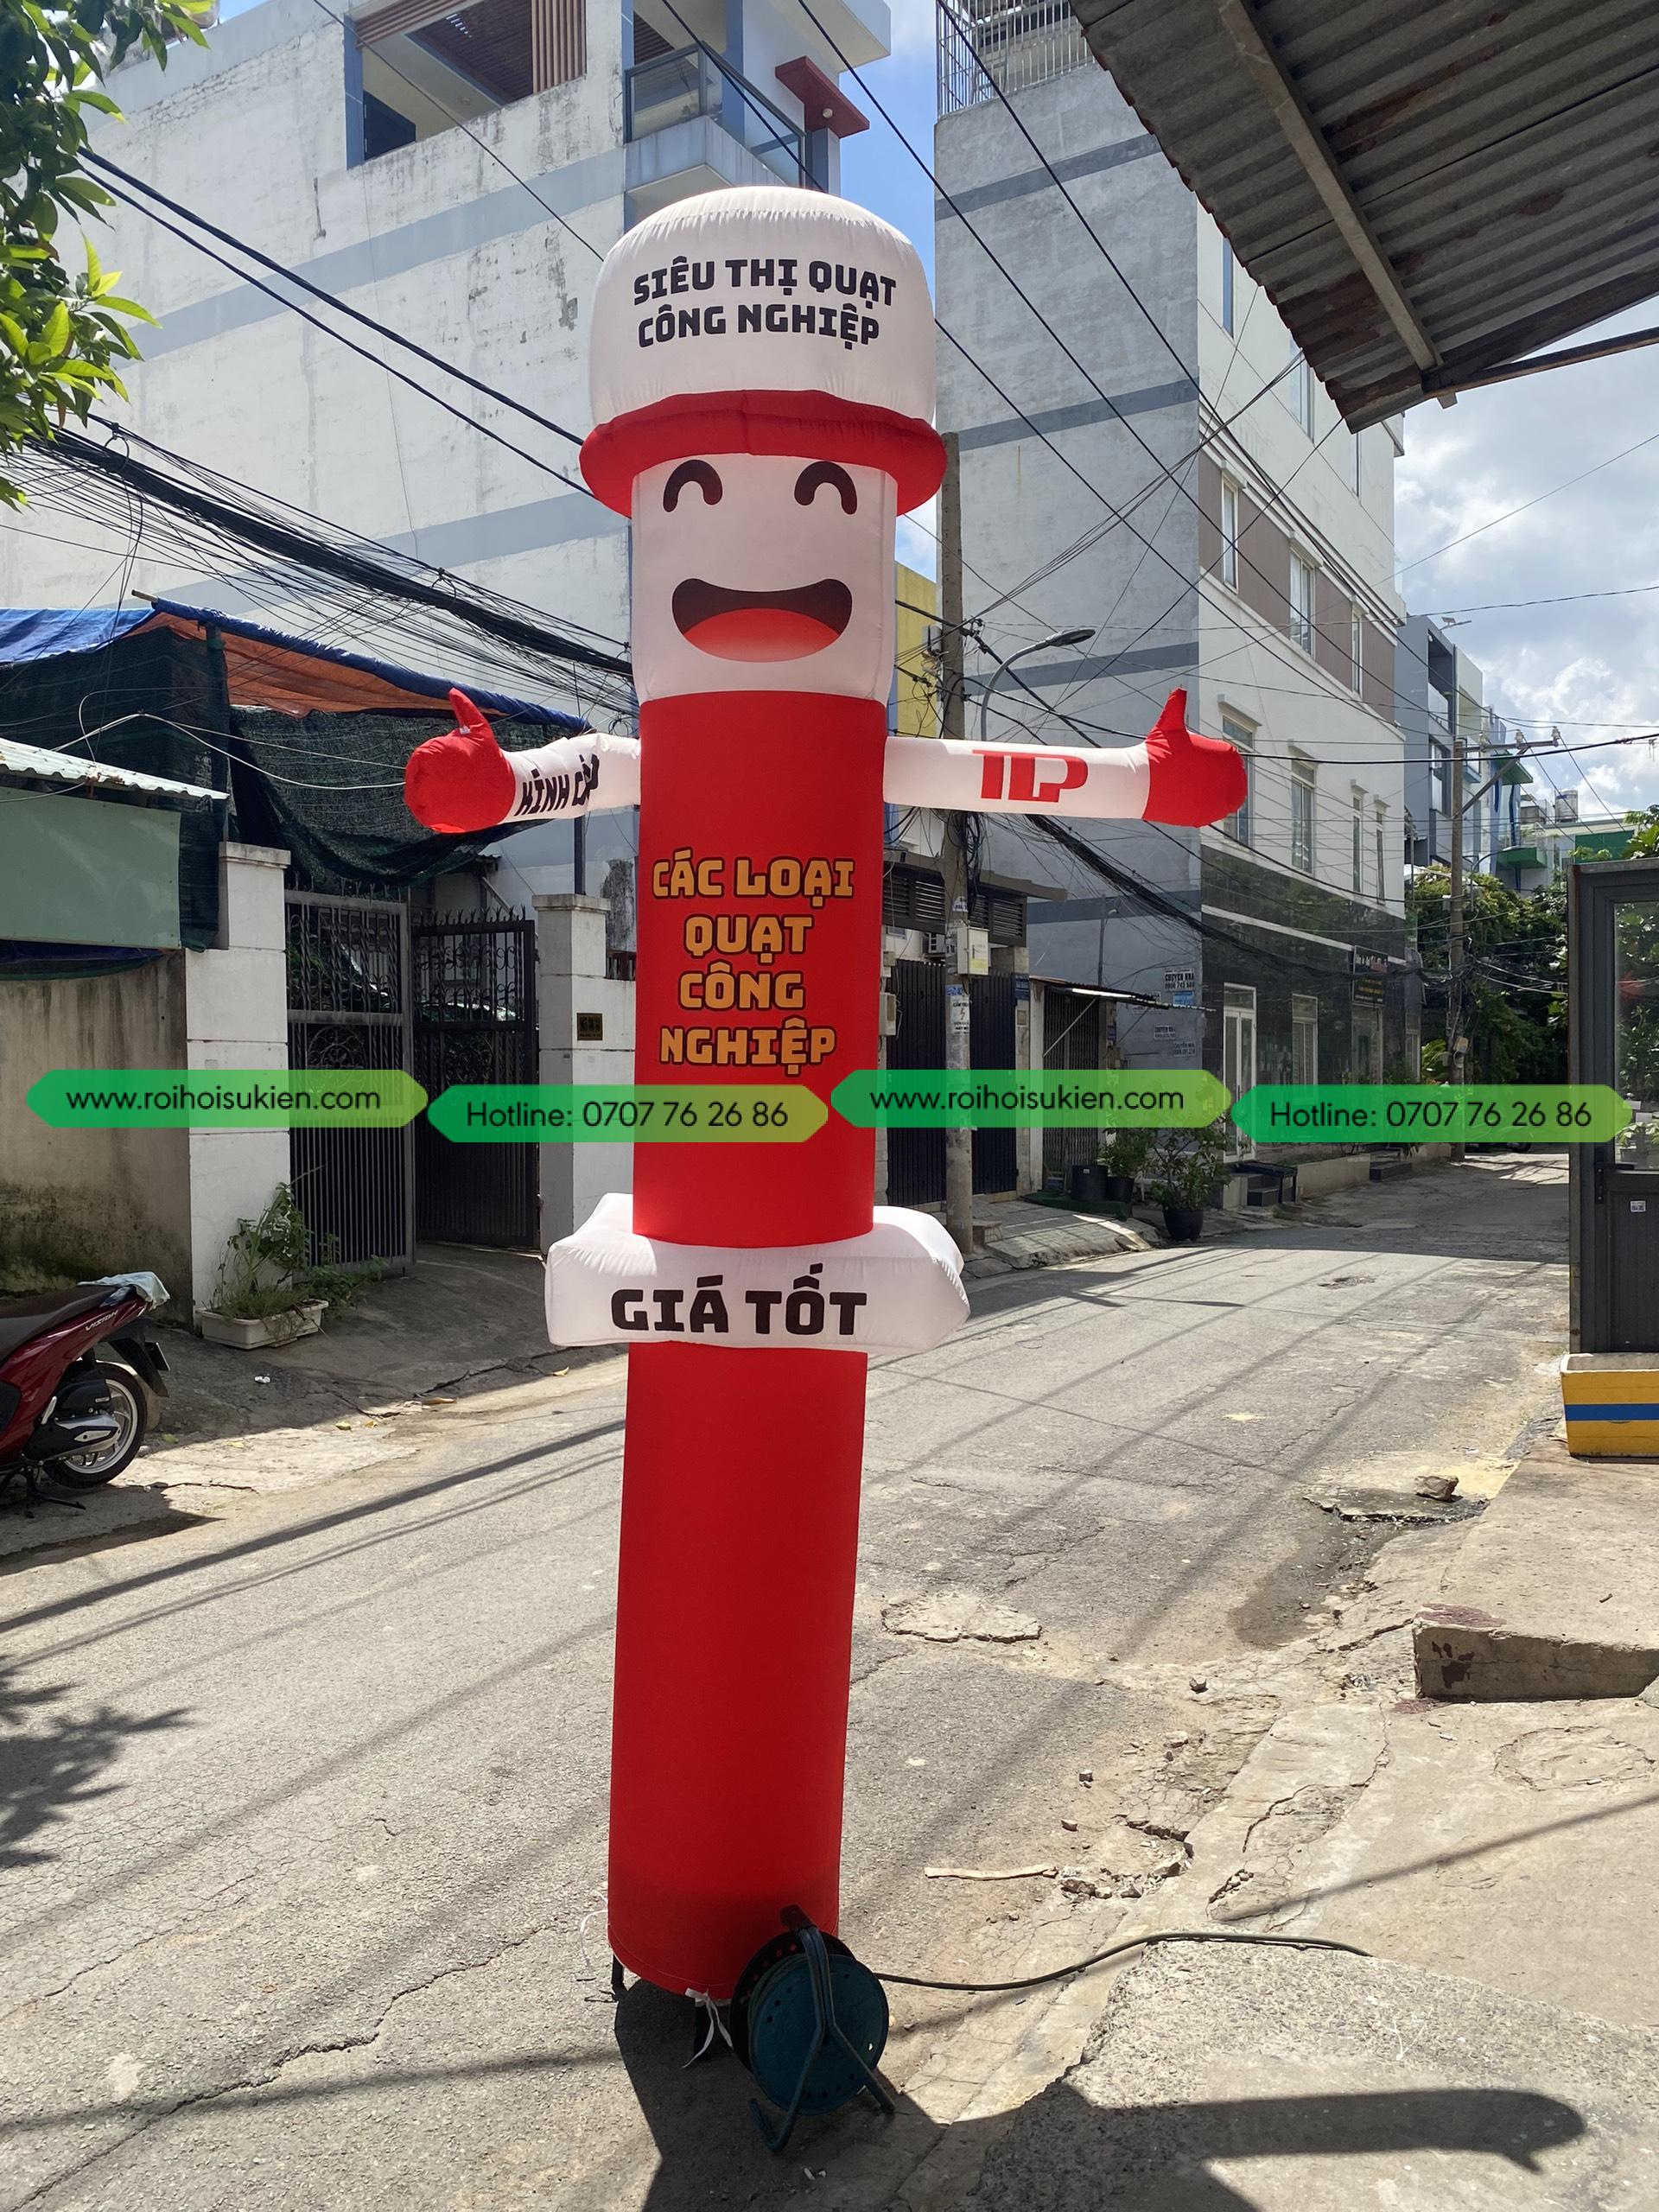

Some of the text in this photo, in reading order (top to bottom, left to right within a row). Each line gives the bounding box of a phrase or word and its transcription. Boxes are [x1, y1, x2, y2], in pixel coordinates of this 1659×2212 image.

[633, 255, 897, 309] SIÊU THỊ QUẠT
[638, 302, 880, 350] CÔNG NGHIỆP
[653, 847, 855, 908] CÁC LOẠI
[683, 914, 814, 964] QUẠT
[678, 961, 805, 1010] CÔNG
[659, 1015, 837, 1076] NGHIỆP
[85, 1309, 118, 1332] VISION
[610, 1262, 868, 1335] GIÁ TỐT
